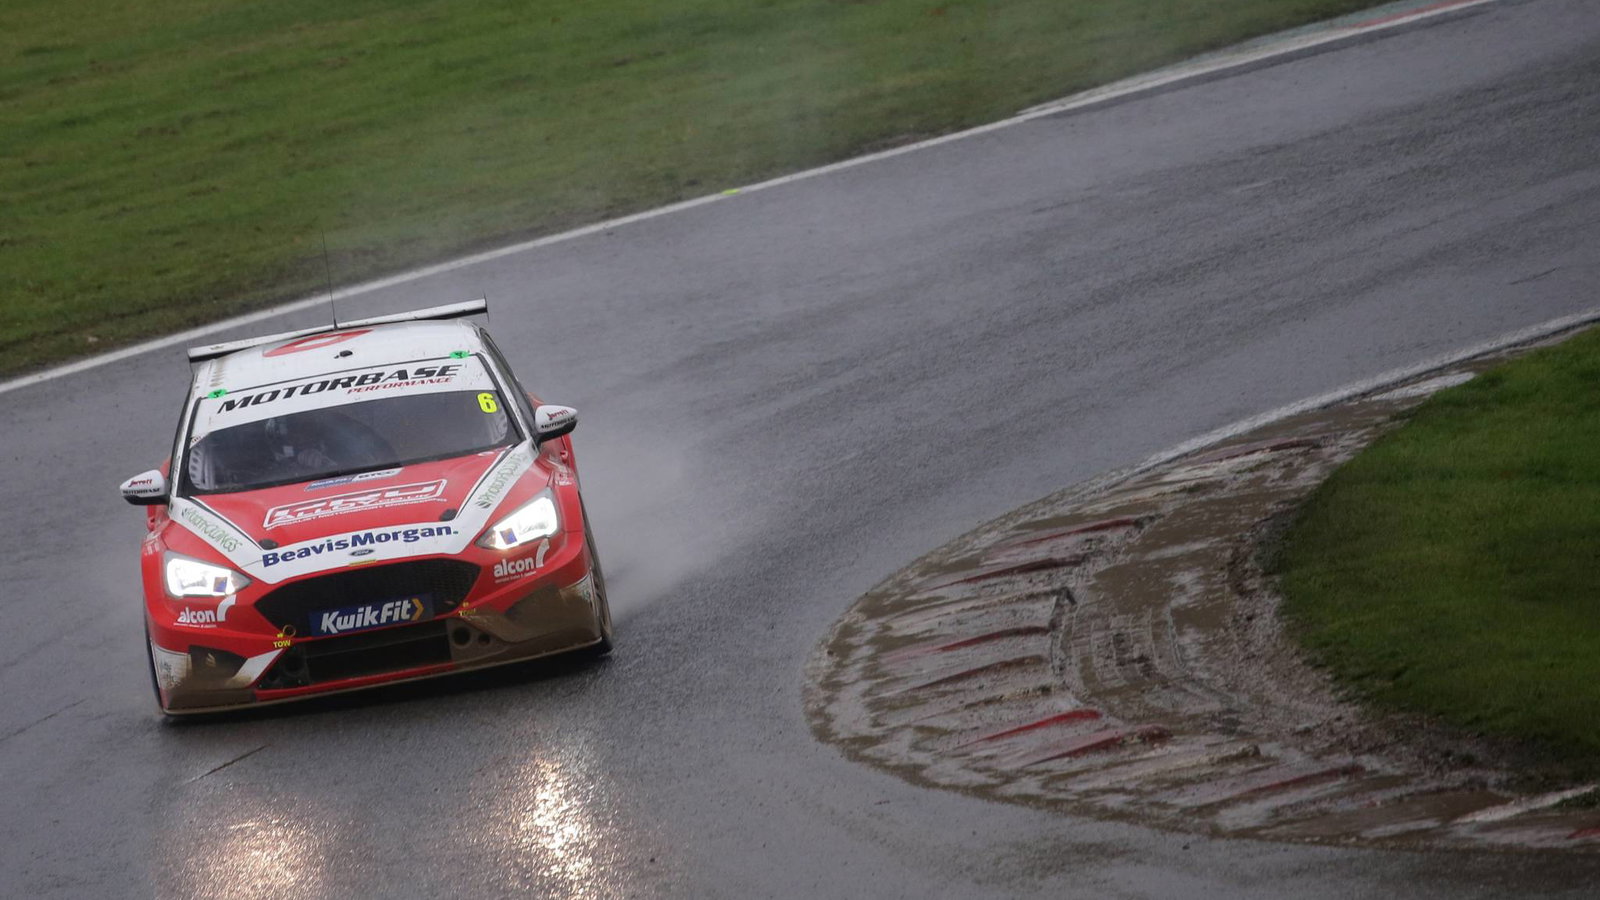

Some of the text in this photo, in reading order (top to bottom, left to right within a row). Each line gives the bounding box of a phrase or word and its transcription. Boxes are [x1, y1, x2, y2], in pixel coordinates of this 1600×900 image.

[217, 364, 462, 414] MOTORBASE
[347, 376, 453, 394] PERFORMANCE
[477, 392, 497, 413] 6
[494, 557, 534, 578] alcon
[177, 606, 216, 623] alcon
[273, 639, 291, 649] TOW
